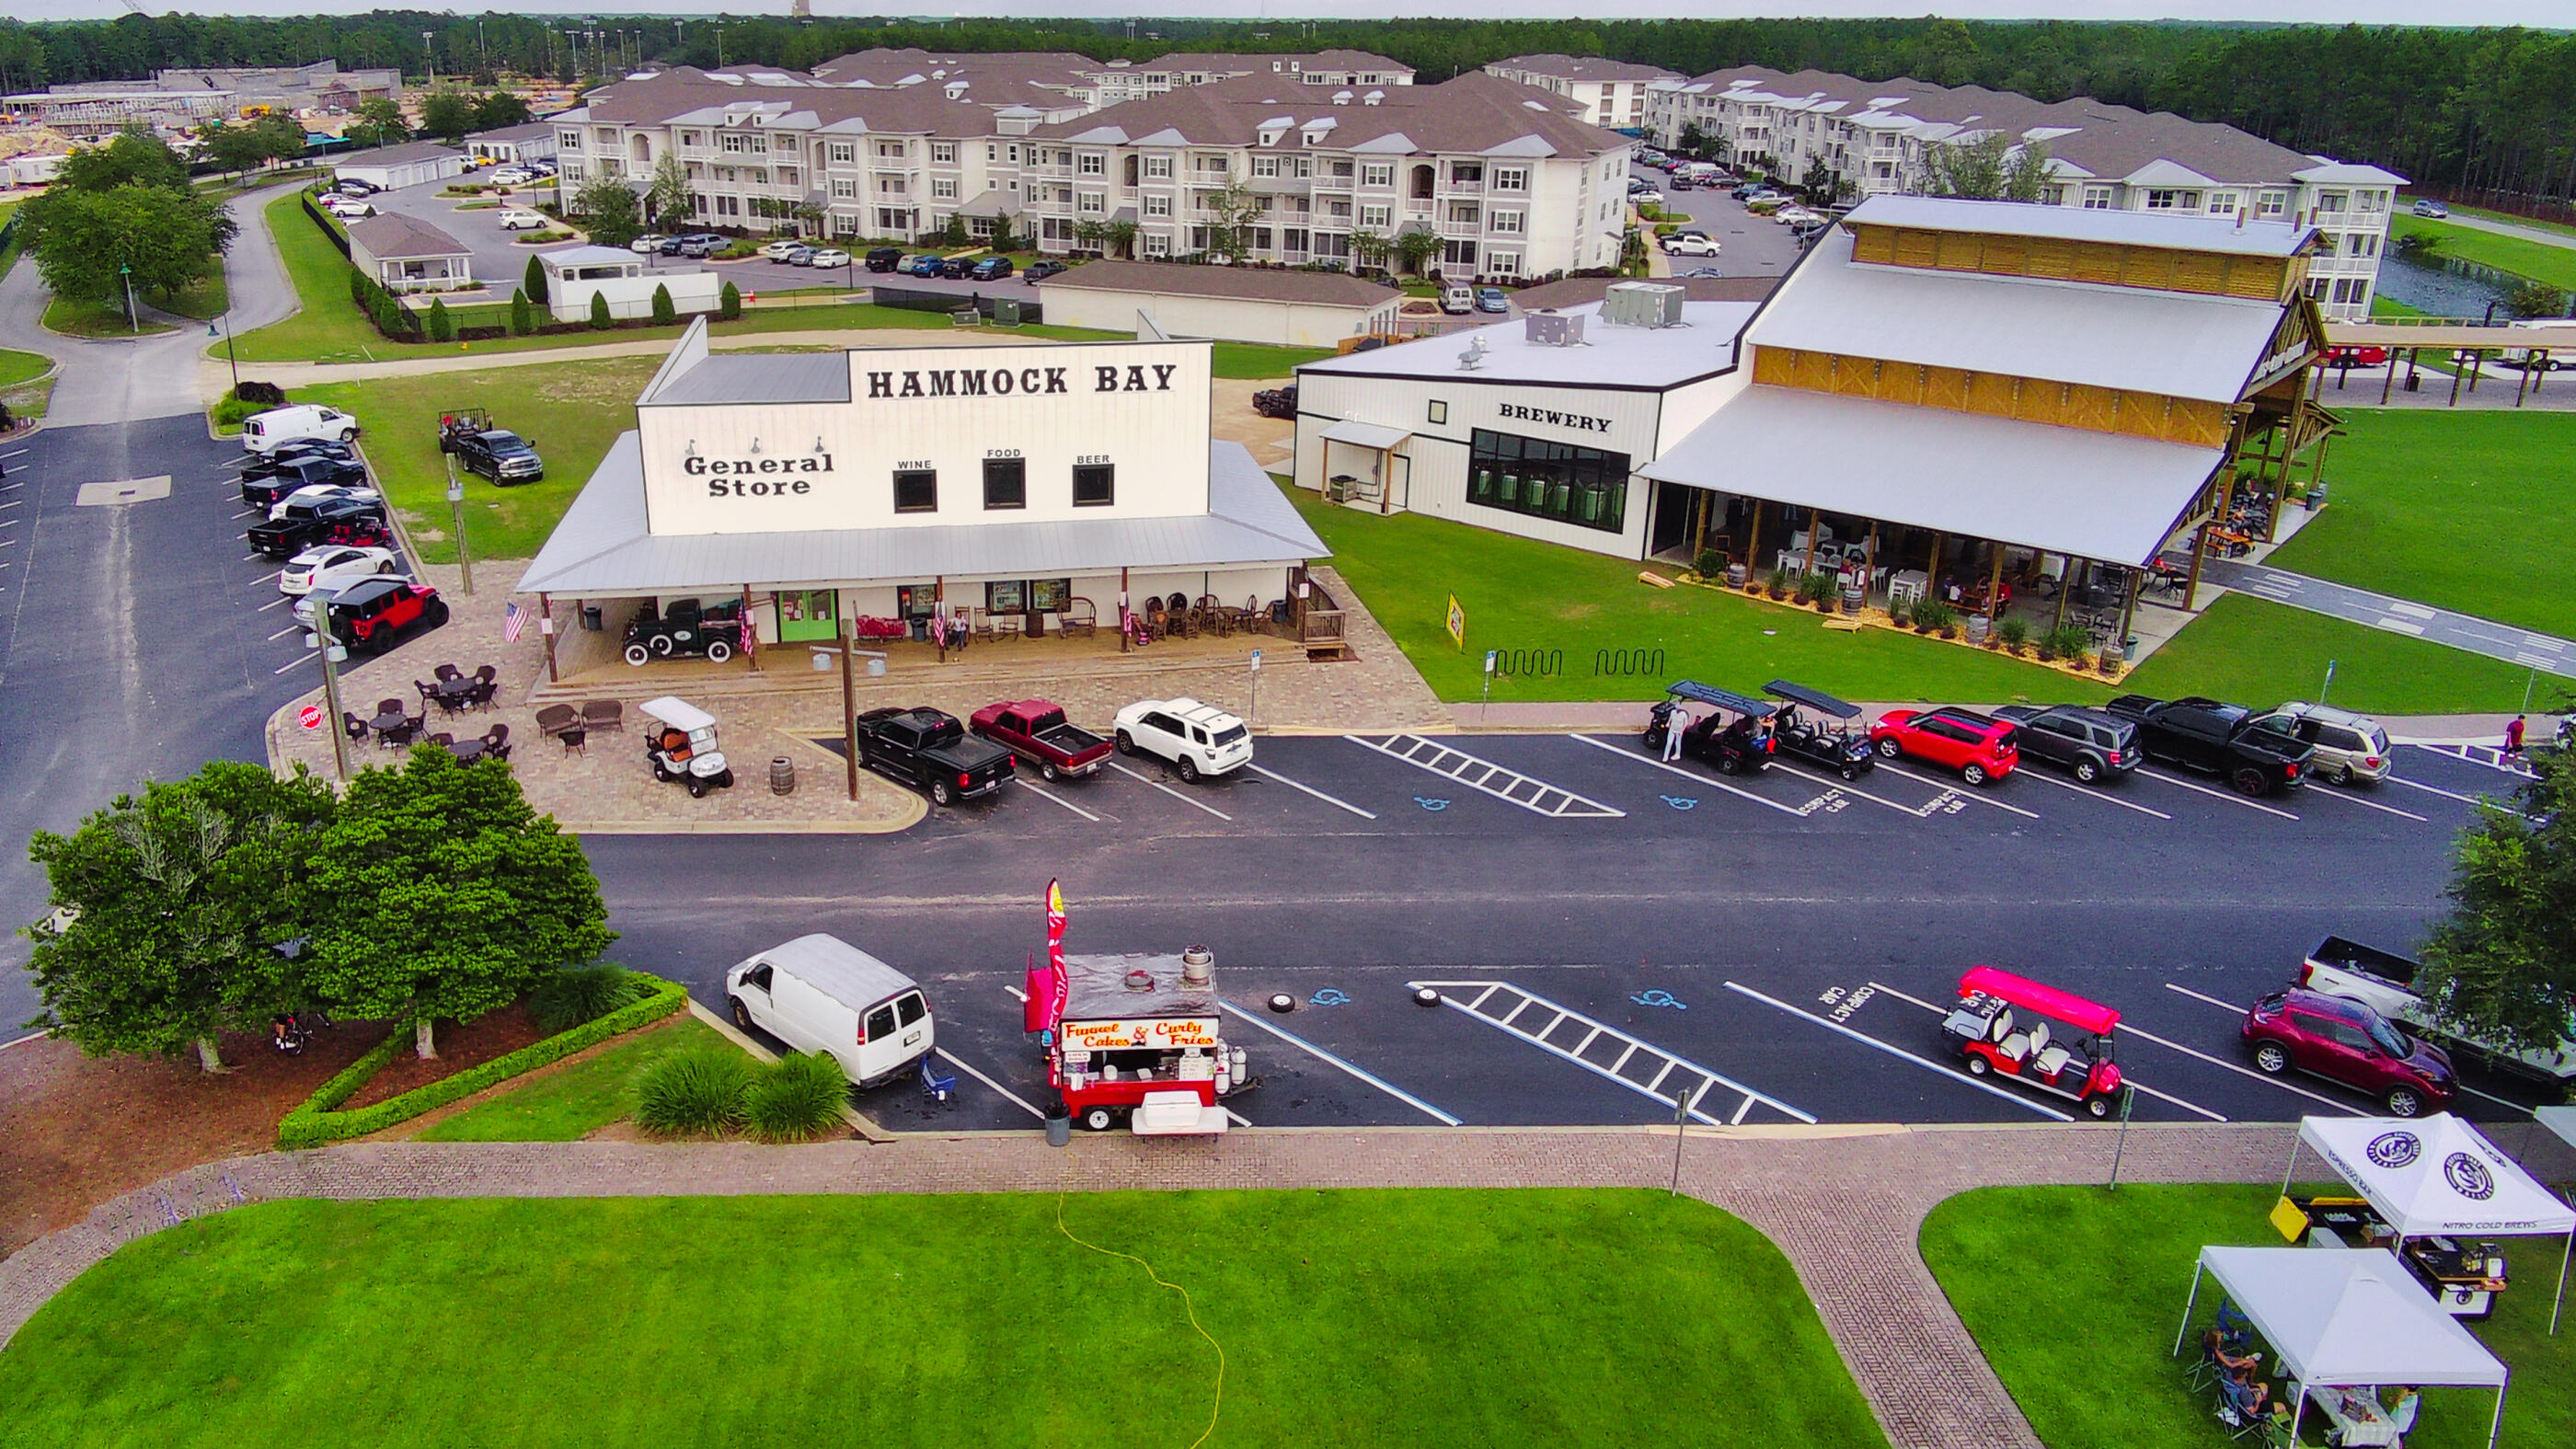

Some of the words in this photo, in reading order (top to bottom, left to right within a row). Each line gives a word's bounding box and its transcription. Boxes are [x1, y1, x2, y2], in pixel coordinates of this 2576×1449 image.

[867, 367, 1067, 398] HAMMOCK
[1095, 364, 1177, 392] BAY
[1499, 403, 1613, 432] BREWERY
[987, 449, 1021, 457] FOOD
[1076, 454, 1110, 464] BEER
[684, 454, 834, 476] General
[898, 460, 932, 469] WINE
[708, 478, 811, 497] Store
[301, 709, 319, 725] STOP
[1798, 788, 1845, 814] COMPACT
[1825, 799, 1850, 812] CAR
[1918, 789, 1960, 815] COMPACT
[1943, 799, 1967, 814] CAR
[1818, 986, 1846, 1005] CAR
[1828, 986, 1875, 1023] COMPACT
[1065, 1022, 1120, 1038] Funnel
[1133, 1026, 1149, 1043] &
[1156, 1021, 1202, 1035] Curly
[1084, 1035, 1131, 1048] Cakes
[1170, 1034, 1213, 1046] Fries
[2328, 1149, 2358, 1182] ESPRESSO
[2443, 1222, 2473, 1230] NITRO
[2475, 1222, 2502, 1230] COLD
[2504, 1221, 2538, 1230] BREWS
